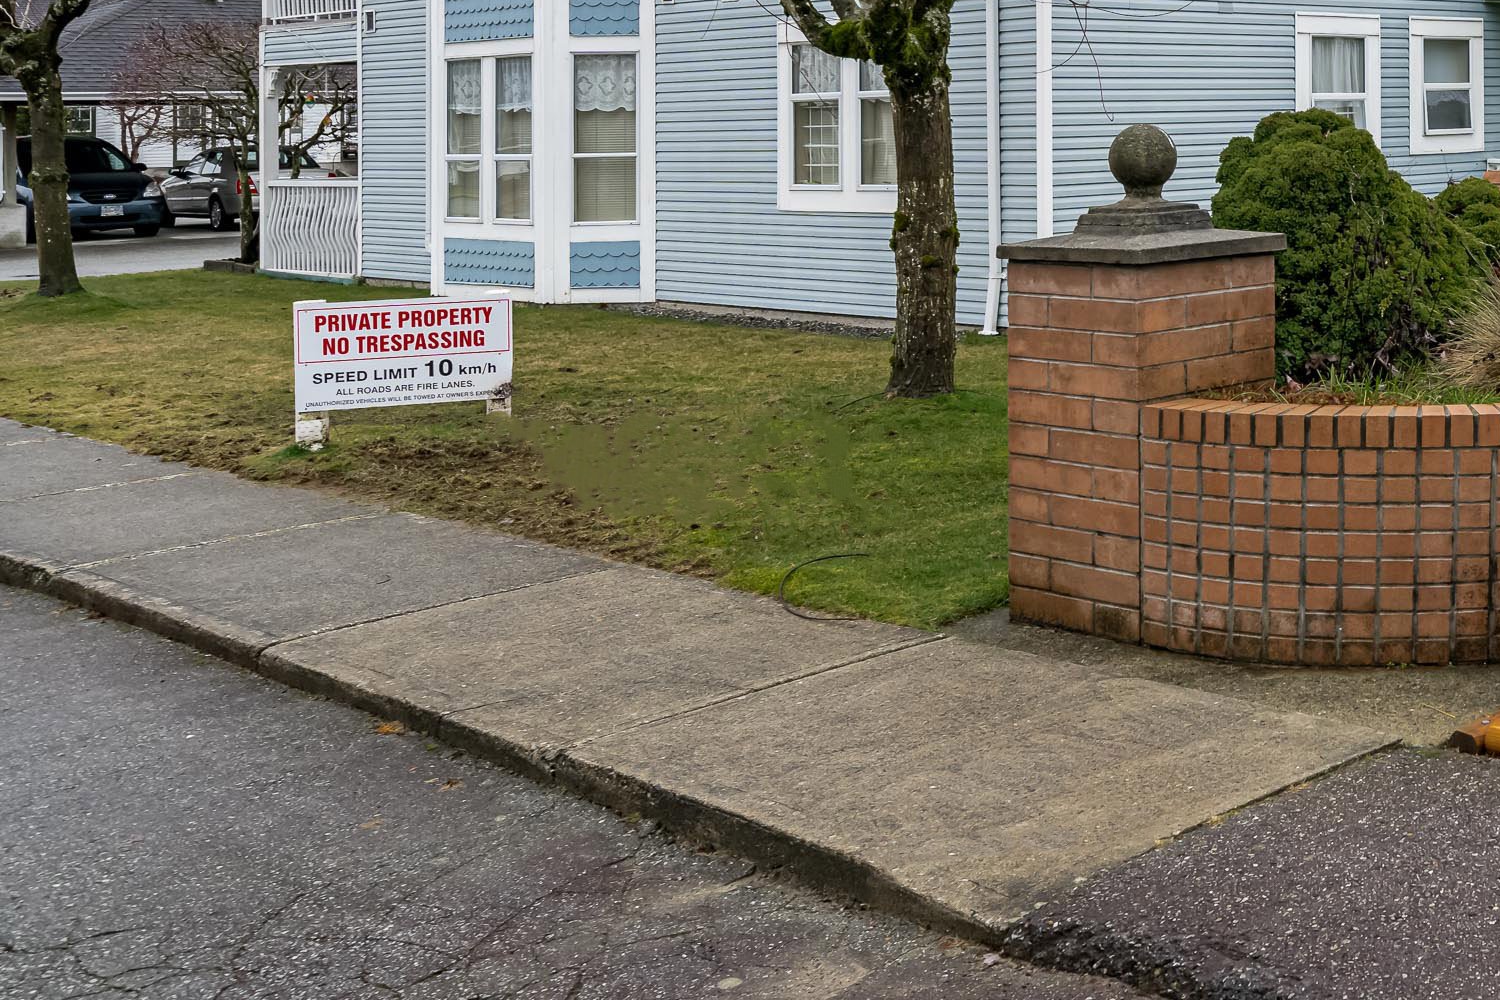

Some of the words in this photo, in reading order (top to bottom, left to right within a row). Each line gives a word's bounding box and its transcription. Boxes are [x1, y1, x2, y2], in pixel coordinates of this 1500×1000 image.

[314, 312, 391, 333] PRIVATE
[398, 306, 493, 328] PROPERTY
[322, 337, 349, 356] NO
[355, 329, 485, 354] TRESPASSING
[312, 370, 368, 385] SPEED
[373, 367, 418, 381] LIMIT
[424, 359, 453, 377] 10
[458, 362, 497, 376] km/h
[336, 388, 354, 396] ALL
[357, 386, 392, 395] ROADS
[394, 383, 414, 392] ARE
[416, 382, 439, 391] FIRE
[441, 380, 476, 389] LANES.
[305, 399, 355, 408] UNAUTHORIZED
